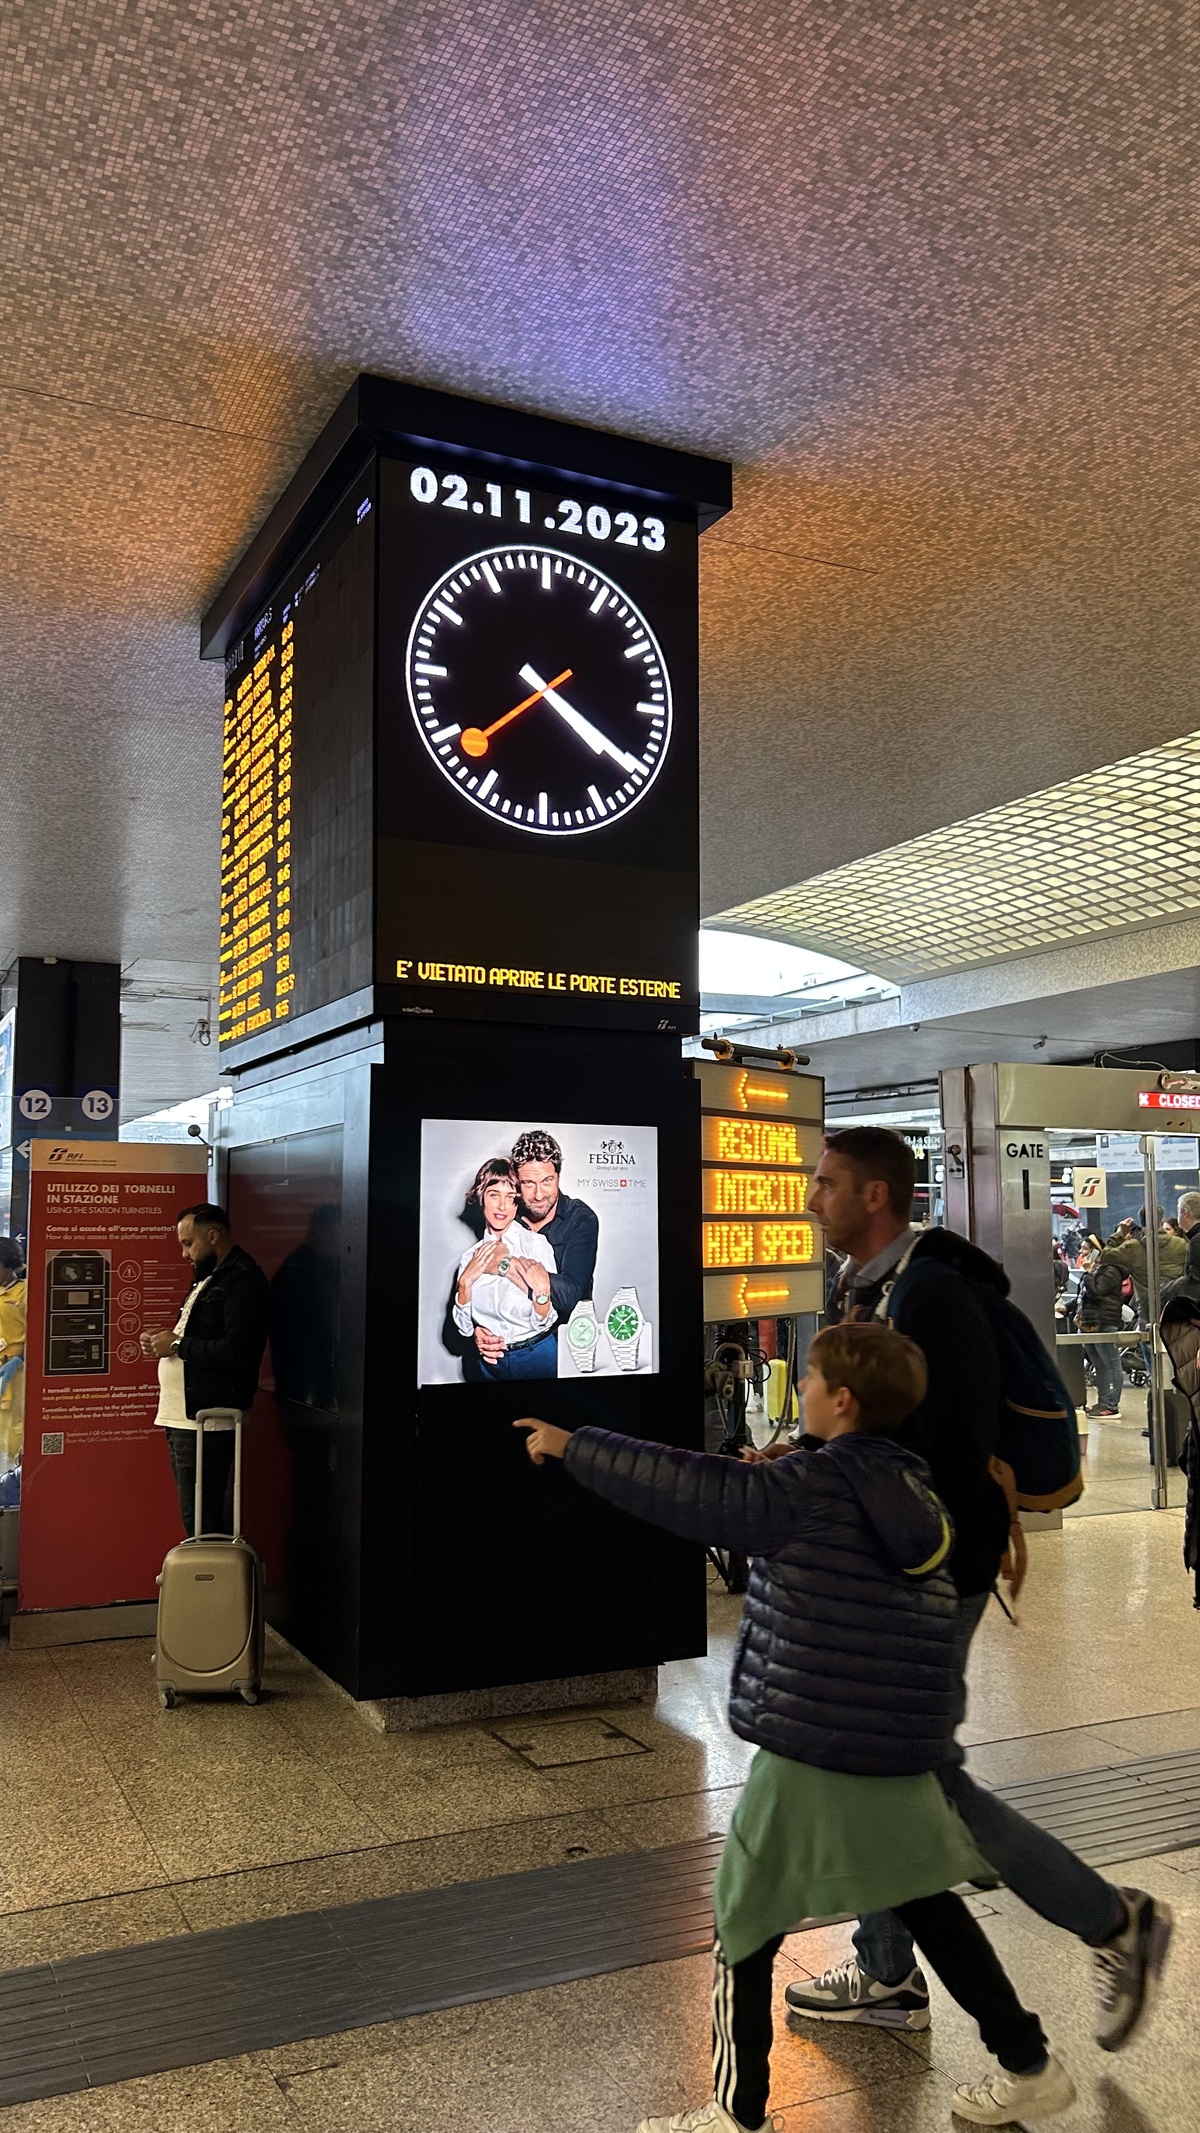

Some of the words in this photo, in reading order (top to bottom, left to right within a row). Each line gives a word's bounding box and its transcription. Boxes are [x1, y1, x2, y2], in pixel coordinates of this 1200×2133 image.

[410, 466, 666, 552] 02.11.2023
[417, 961, 486, 984] VIETATO
[489, 967, 545, 989] APRIRE
[548, 972, 567, 991] LE
[570, 974, 616, 994] PORTE
[620, 978, 681, 999] ESTERNE
[25, 1097, 47, 1113] 12
[87, 1097, 109, 1113] 13
[1159, 1094, 1200, 1108] CLOSED
[718, 1121, 804, 1164] REGIONAL
[1006, 1143, 1044, 1158] GATE
[589, 1153, 636, 1165] FESTINA
[47, 1183, 99, 1193] UTILIZZO
[101, 1184, 120, 1193] DEI
[124, 1184, 176, 1194] TORNELLI
[577, 1178, 590, 1187] MY
[592, 1178, 619, 1187] SWISS
[628, 1179, 647, 1188] TIME
[47, 1194, 60, 1203] IN
[63, 1195, 119, 1204] STAZIONE
[714, 1172, 808, 1212] INTERCITY
[46, 1206, 72, 1214] USING
[707, 1225, 754, 1265] HIGH
[761, 1224, 814, 1262] SPEED
